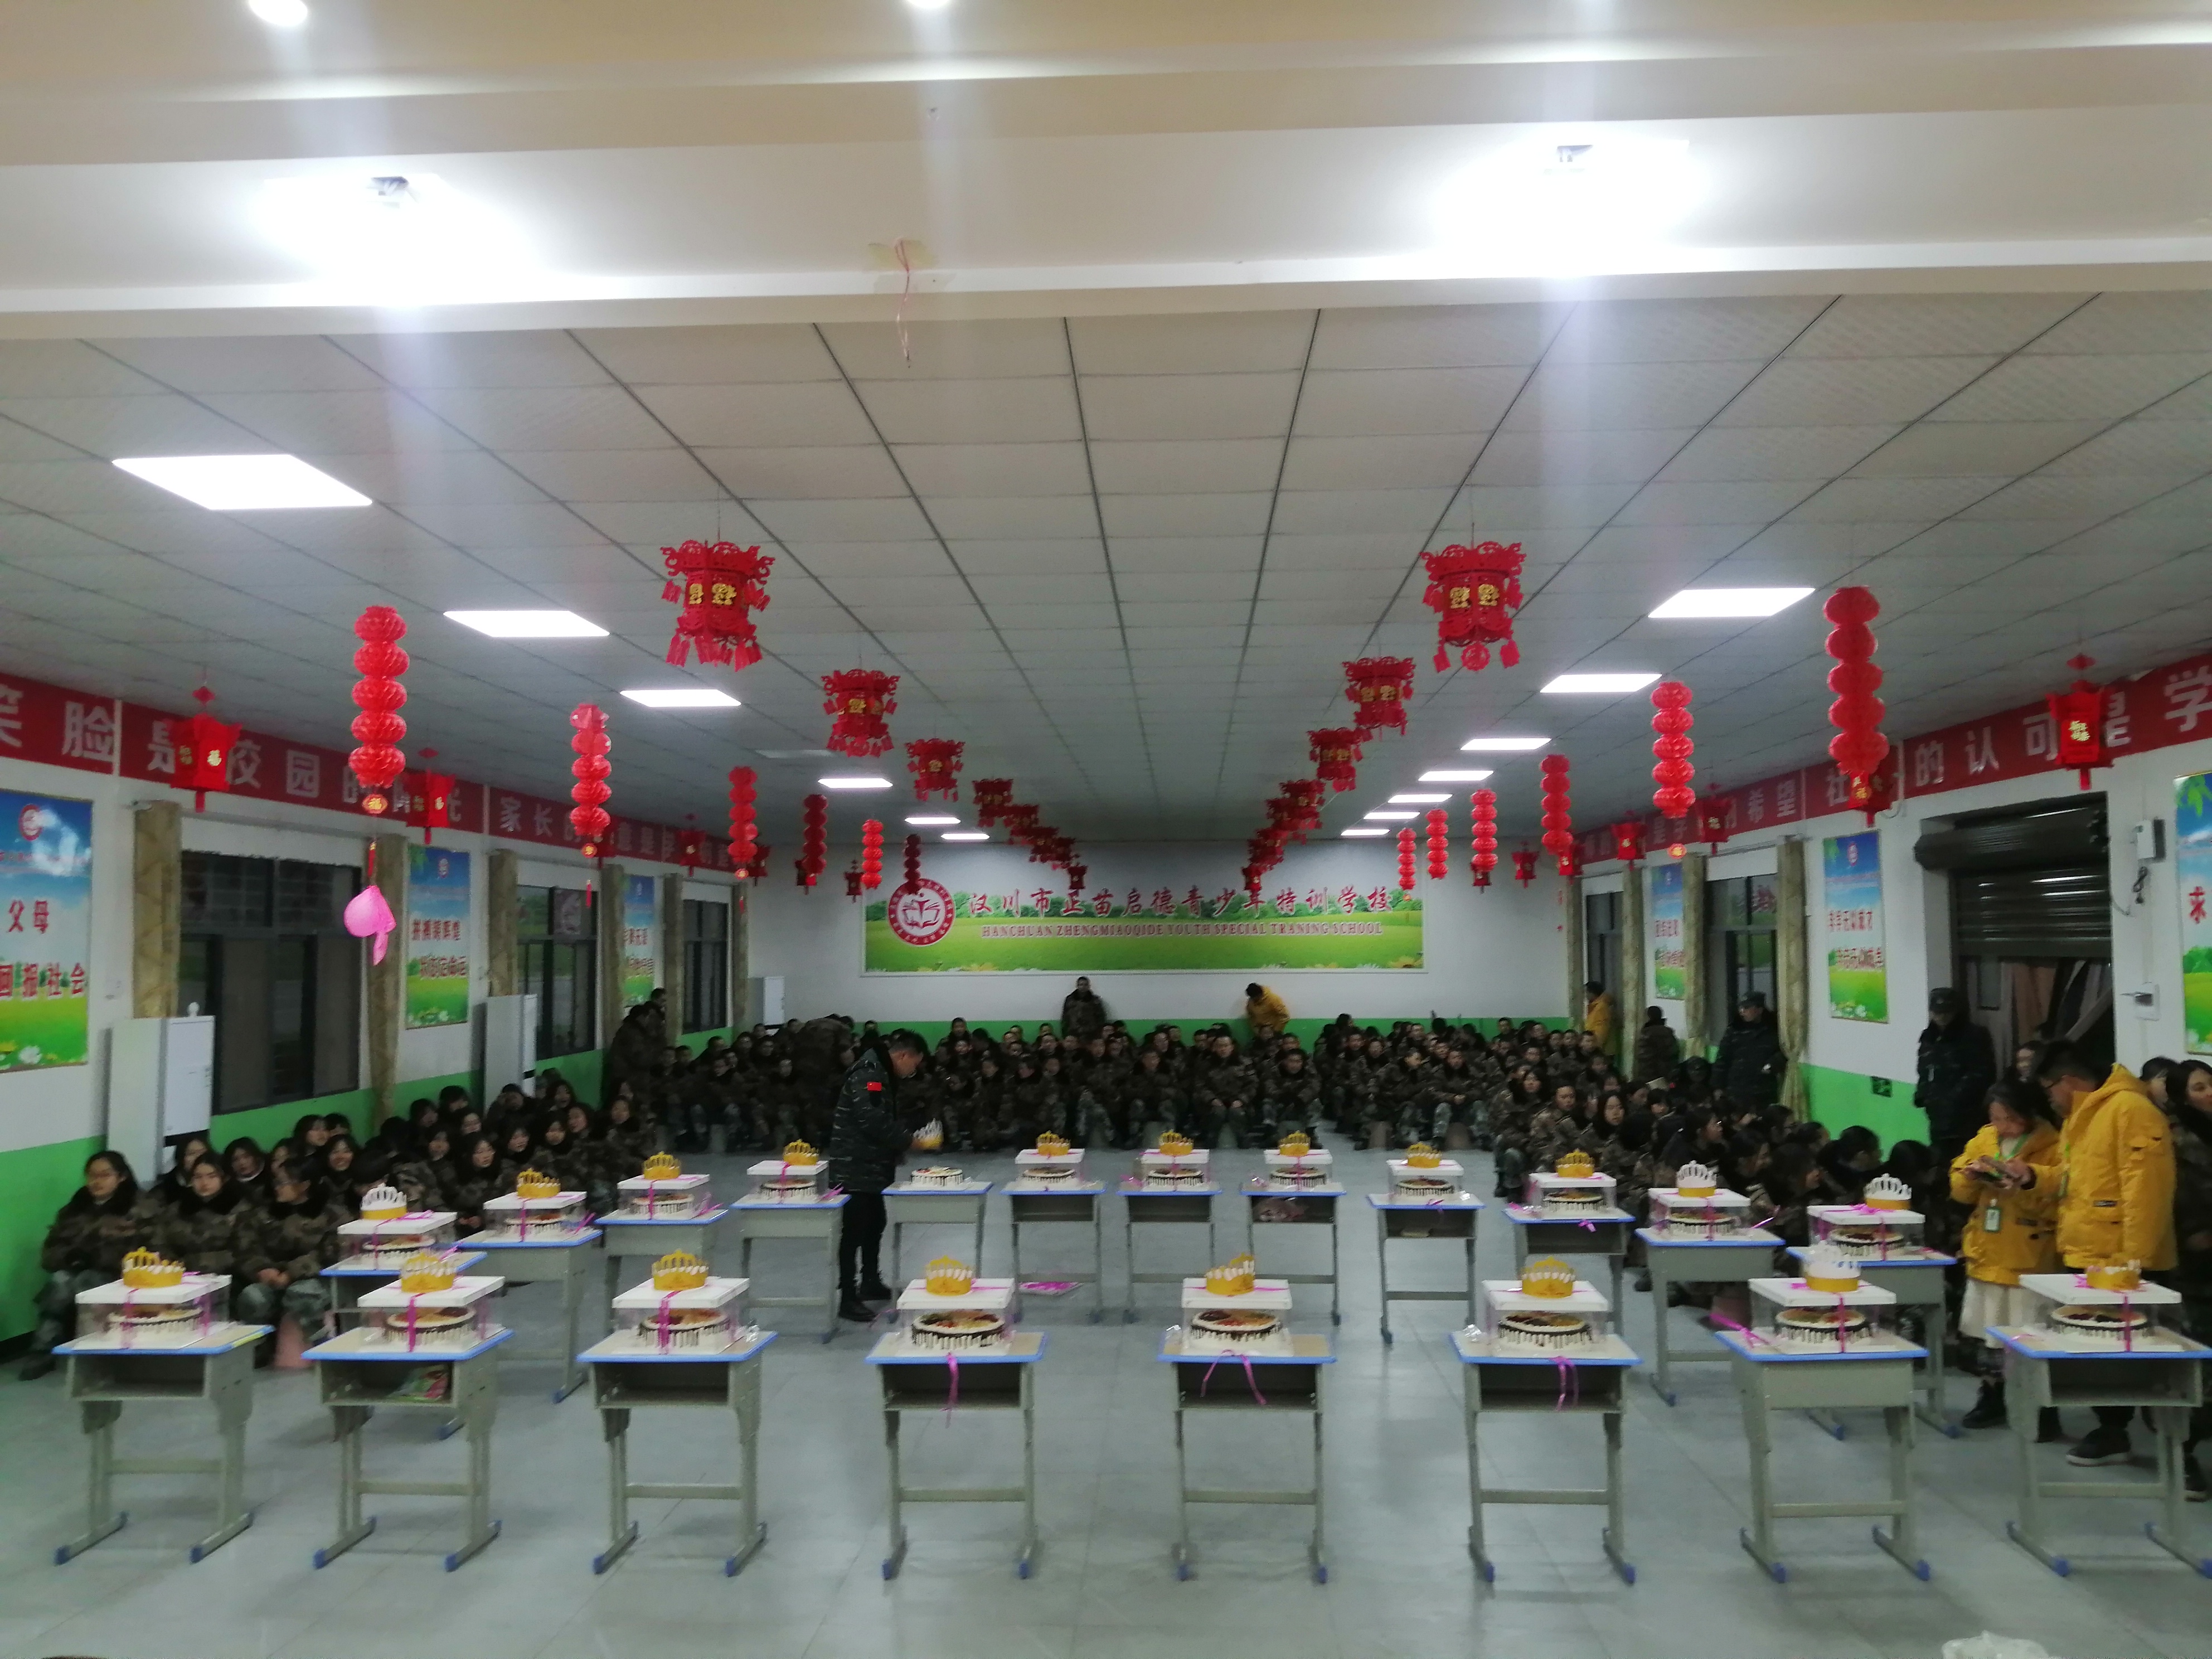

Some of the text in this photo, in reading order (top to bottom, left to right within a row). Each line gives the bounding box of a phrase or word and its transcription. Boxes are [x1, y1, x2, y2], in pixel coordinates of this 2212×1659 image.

[7, 900, 50, 934] 父母
[969, 884, 1391, 917] 汉川市正苗启德青少年特训学校
[1167, 923, 1211, 935] YOUTH
[1214, 923, 1267, 935] SPECIAL
[1332, 922, 1382, 935] SCHOOL
